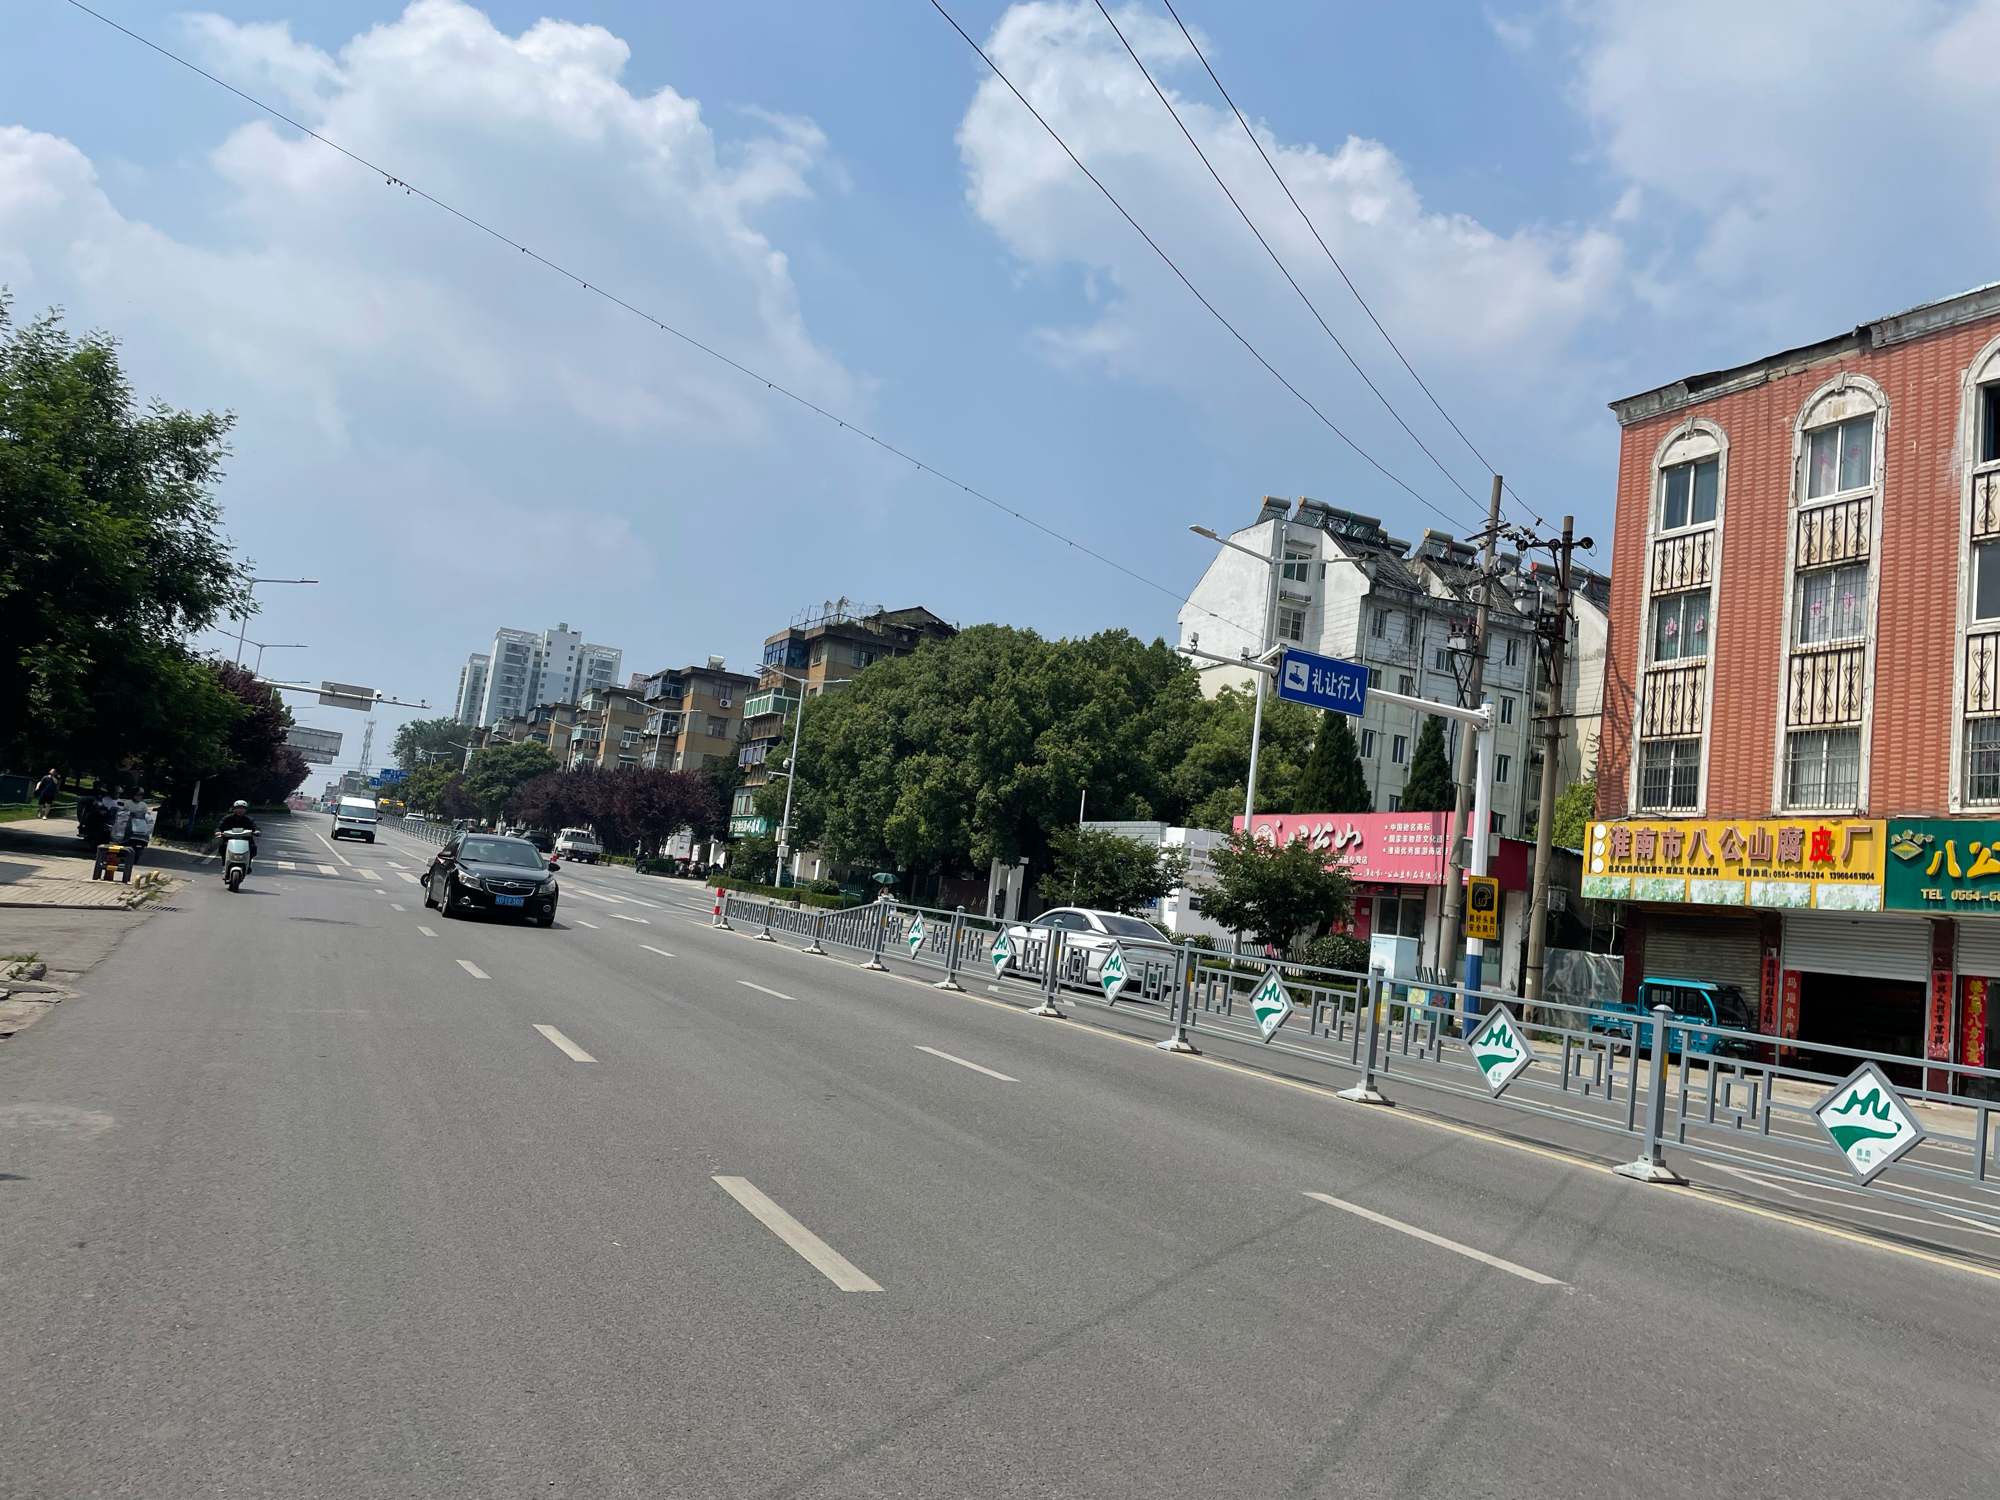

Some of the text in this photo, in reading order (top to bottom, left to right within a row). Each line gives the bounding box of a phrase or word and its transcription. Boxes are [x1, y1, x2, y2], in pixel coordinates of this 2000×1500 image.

[1312, 668, 1361, 702] 礼让行人
[1608, 825, 1872, 863] 淮南市八公山腐皮厂
